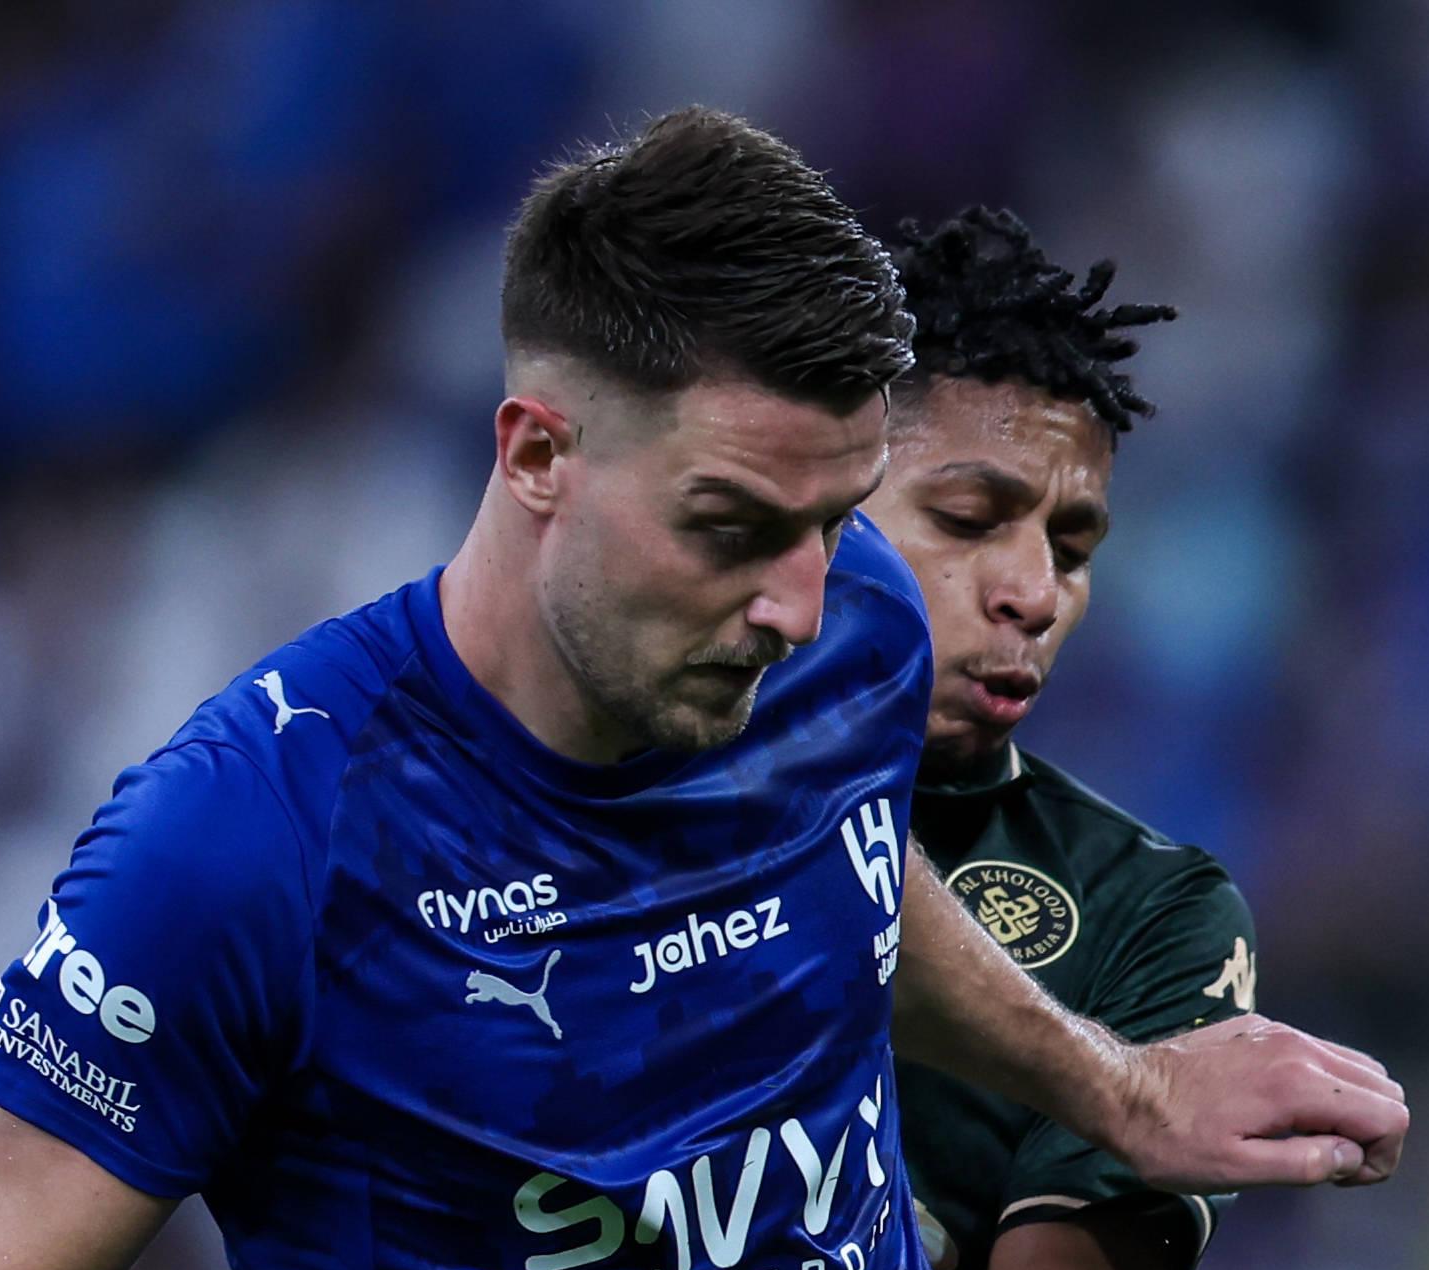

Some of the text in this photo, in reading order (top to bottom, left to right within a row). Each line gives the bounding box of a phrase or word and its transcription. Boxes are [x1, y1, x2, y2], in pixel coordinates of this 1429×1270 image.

[417, 873, 558, 934] flynas
[957, 869, 1067, 918] AL KHOLOOD
[484, 911, 568, 944] طيران ناس
[1010, 933, 1061, 959] RABIA
[2, 998, 141, 1112] SANABIL
